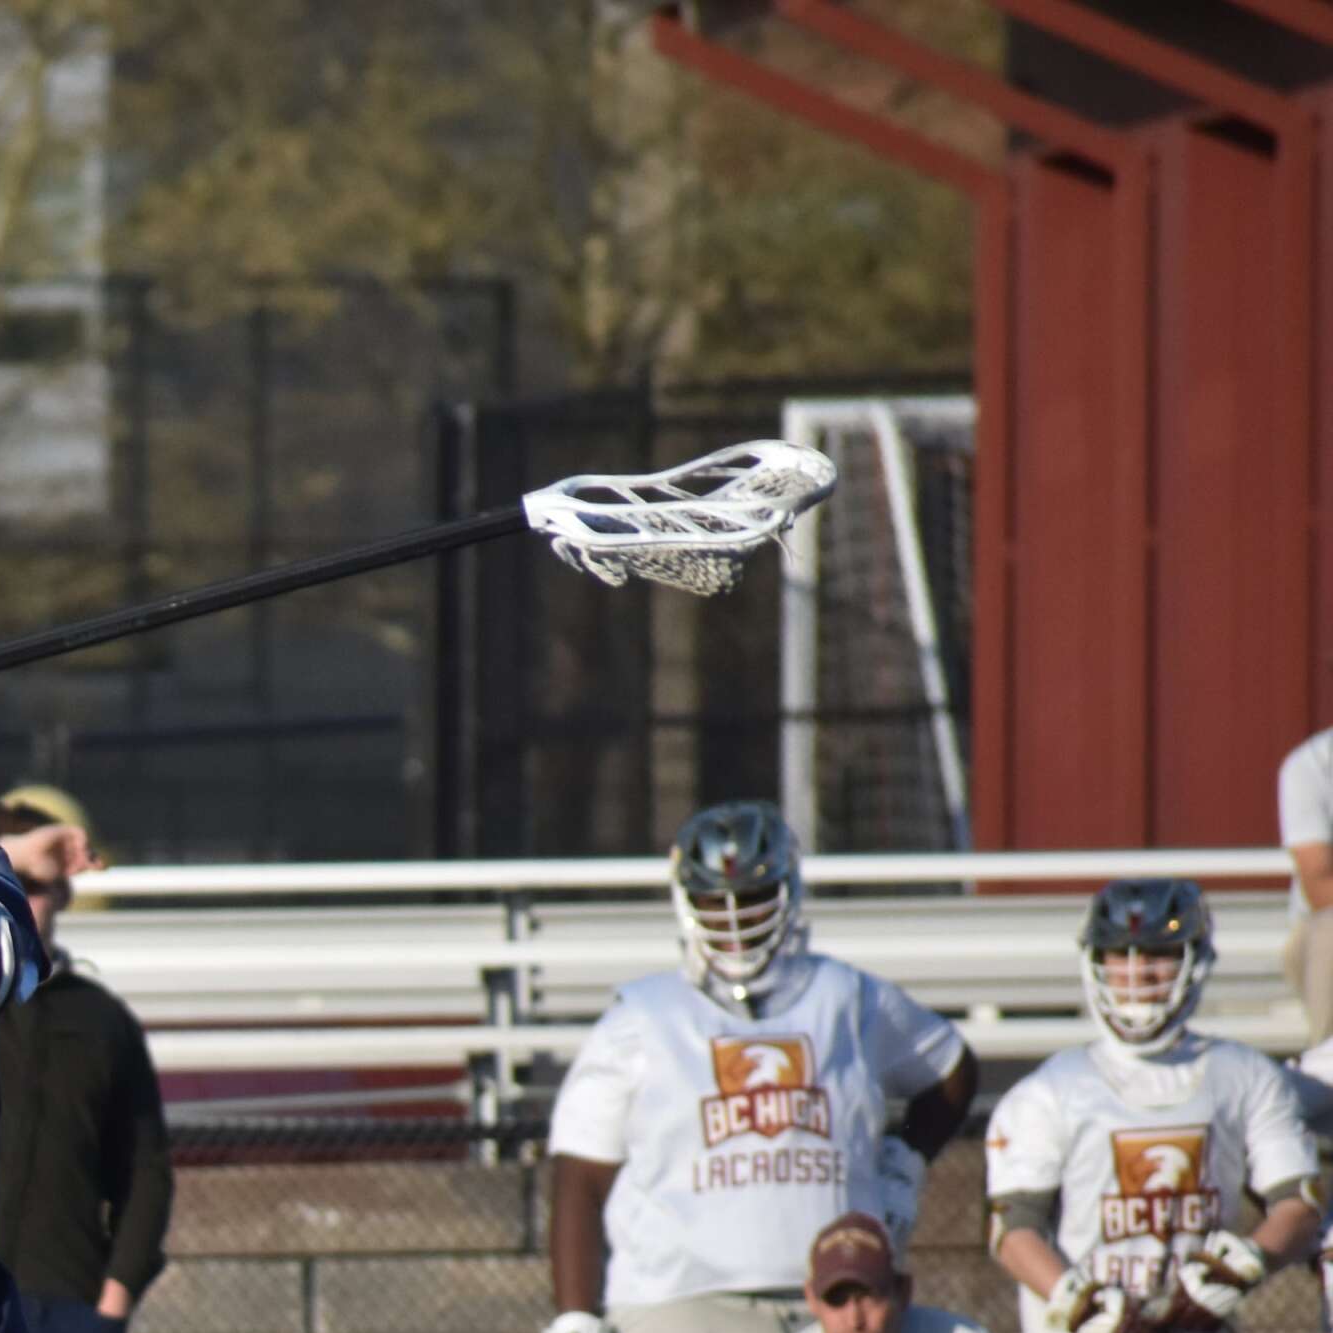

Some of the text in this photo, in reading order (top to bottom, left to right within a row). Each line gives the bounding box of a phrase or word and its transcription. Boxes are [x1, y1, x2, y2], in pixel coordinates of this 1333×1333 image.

[704, 1094, 751, 1141] BC
[693, 1149, 845, 1195] LACROSSE
[1104, 1197, 1149, 1239] BC
